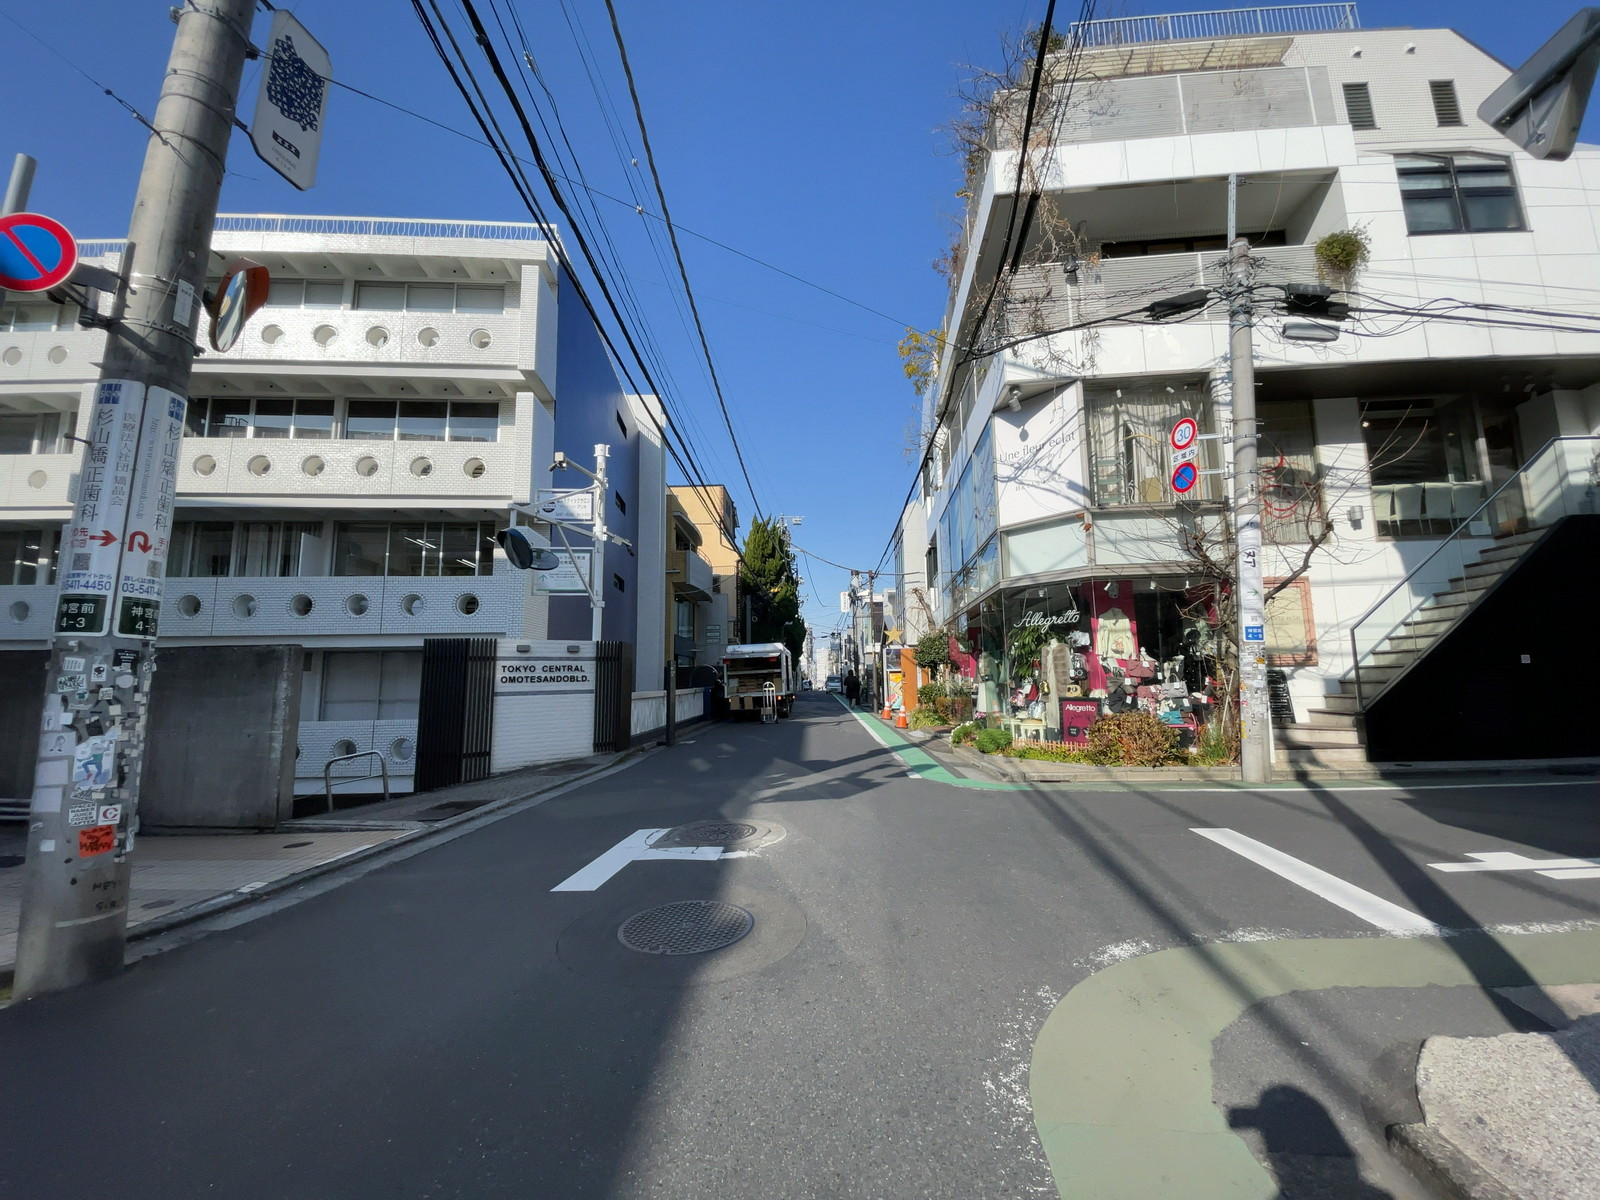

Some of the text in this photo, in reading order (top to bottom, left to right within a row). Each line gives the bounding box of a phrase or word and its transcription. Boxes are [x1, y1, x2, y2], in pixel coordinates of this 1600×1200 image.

[1177, 426, 1191, 443] 30
[999, 449, 1020, 463] Une
[1173, 449, 1195, 463] 区域内
[60, 617, 86, 628] 4-3
[135, 621, 156, 633] 4-3
[1013, 609, 1081, 633] Allegretto
[501, 665, 586, 673] TOKYO CENTRAL
[1065, 703, 1096, 713] Allegretto
